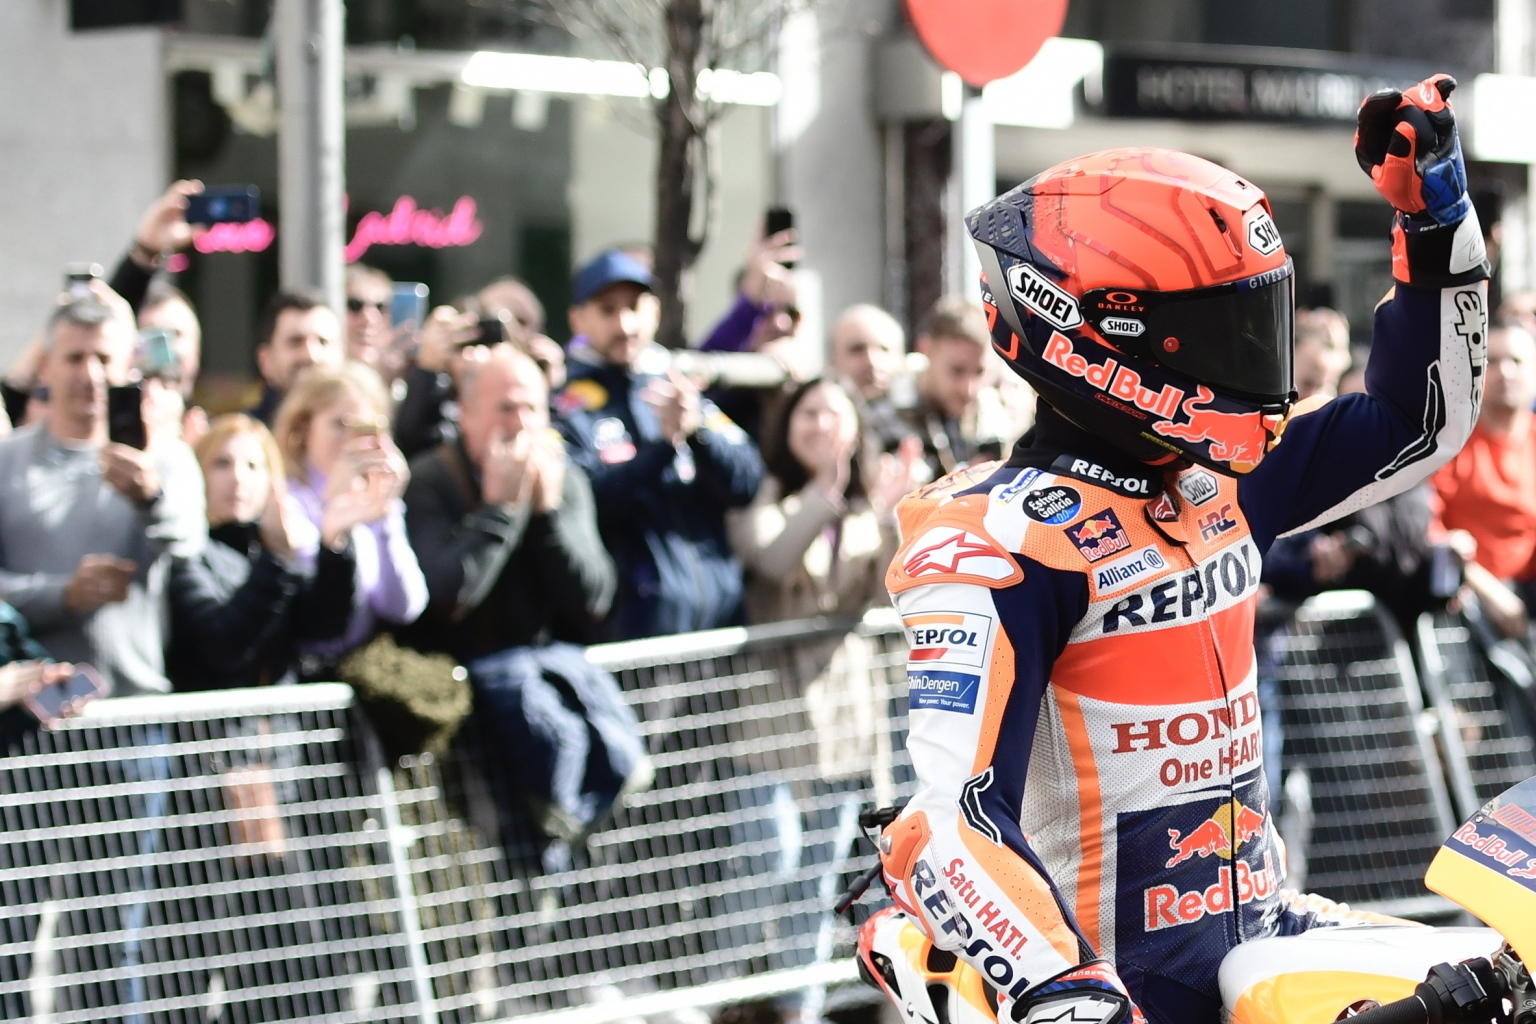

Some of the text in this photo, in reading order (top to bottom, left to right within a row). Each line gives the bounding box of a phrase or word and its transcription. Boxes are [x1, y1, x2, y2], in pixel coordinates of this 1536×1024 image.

[1015, 272, 1074, 323] SHOEI
[1097, 302, 1145, 312] OAKLEY
[1107, 320, 1139, 333] SHOEI
[1070, 458, 1149, 494] REPSOL
[1184, 475, 1215, 501] SHOEI
[1028, 489, 1067, 511] Estrella
[1038, 497, 1074, 518] Galicia
[1098, 560, 1147, 590] Allianz
[1103, 544, 1257, 634] REPSOL
[913, 629, 978, 647] EPSOL
[1111, 691, 1257, 754] HOND
[1160, 757, 1213, 787] One
[942, 858, 981, 909] Satu
